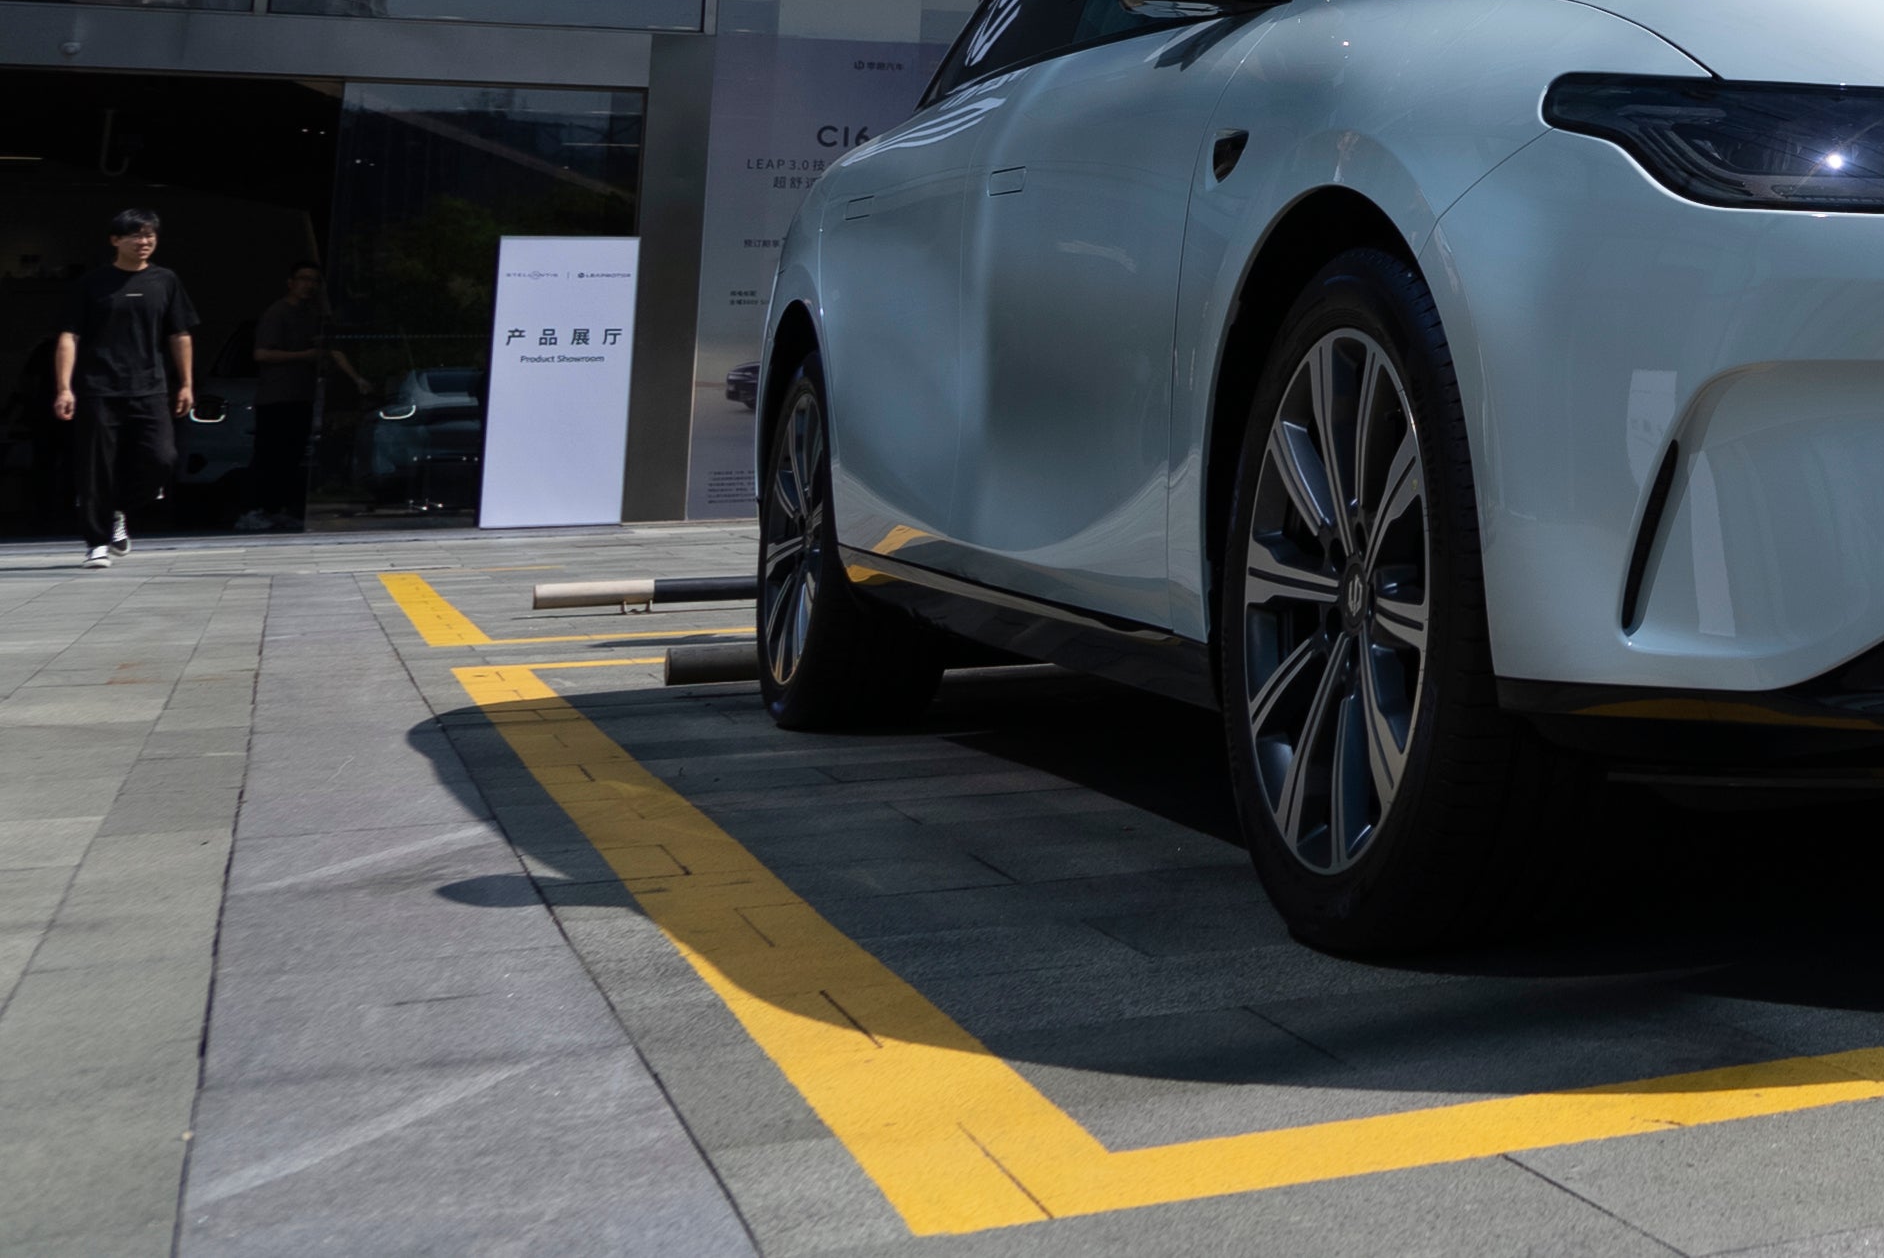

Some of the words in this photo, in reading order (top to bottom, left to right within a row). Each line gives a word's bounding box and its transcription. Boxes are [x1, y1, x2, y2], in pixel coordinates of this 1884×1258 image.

[746, 158, 786, 170] LEAP
[788, 159, 810, 171] 3.0
[505, 327, 622, 346] 产品展厅
[520, 355, 555, 364] Product
[557, 355, 605, 364] Showroom
